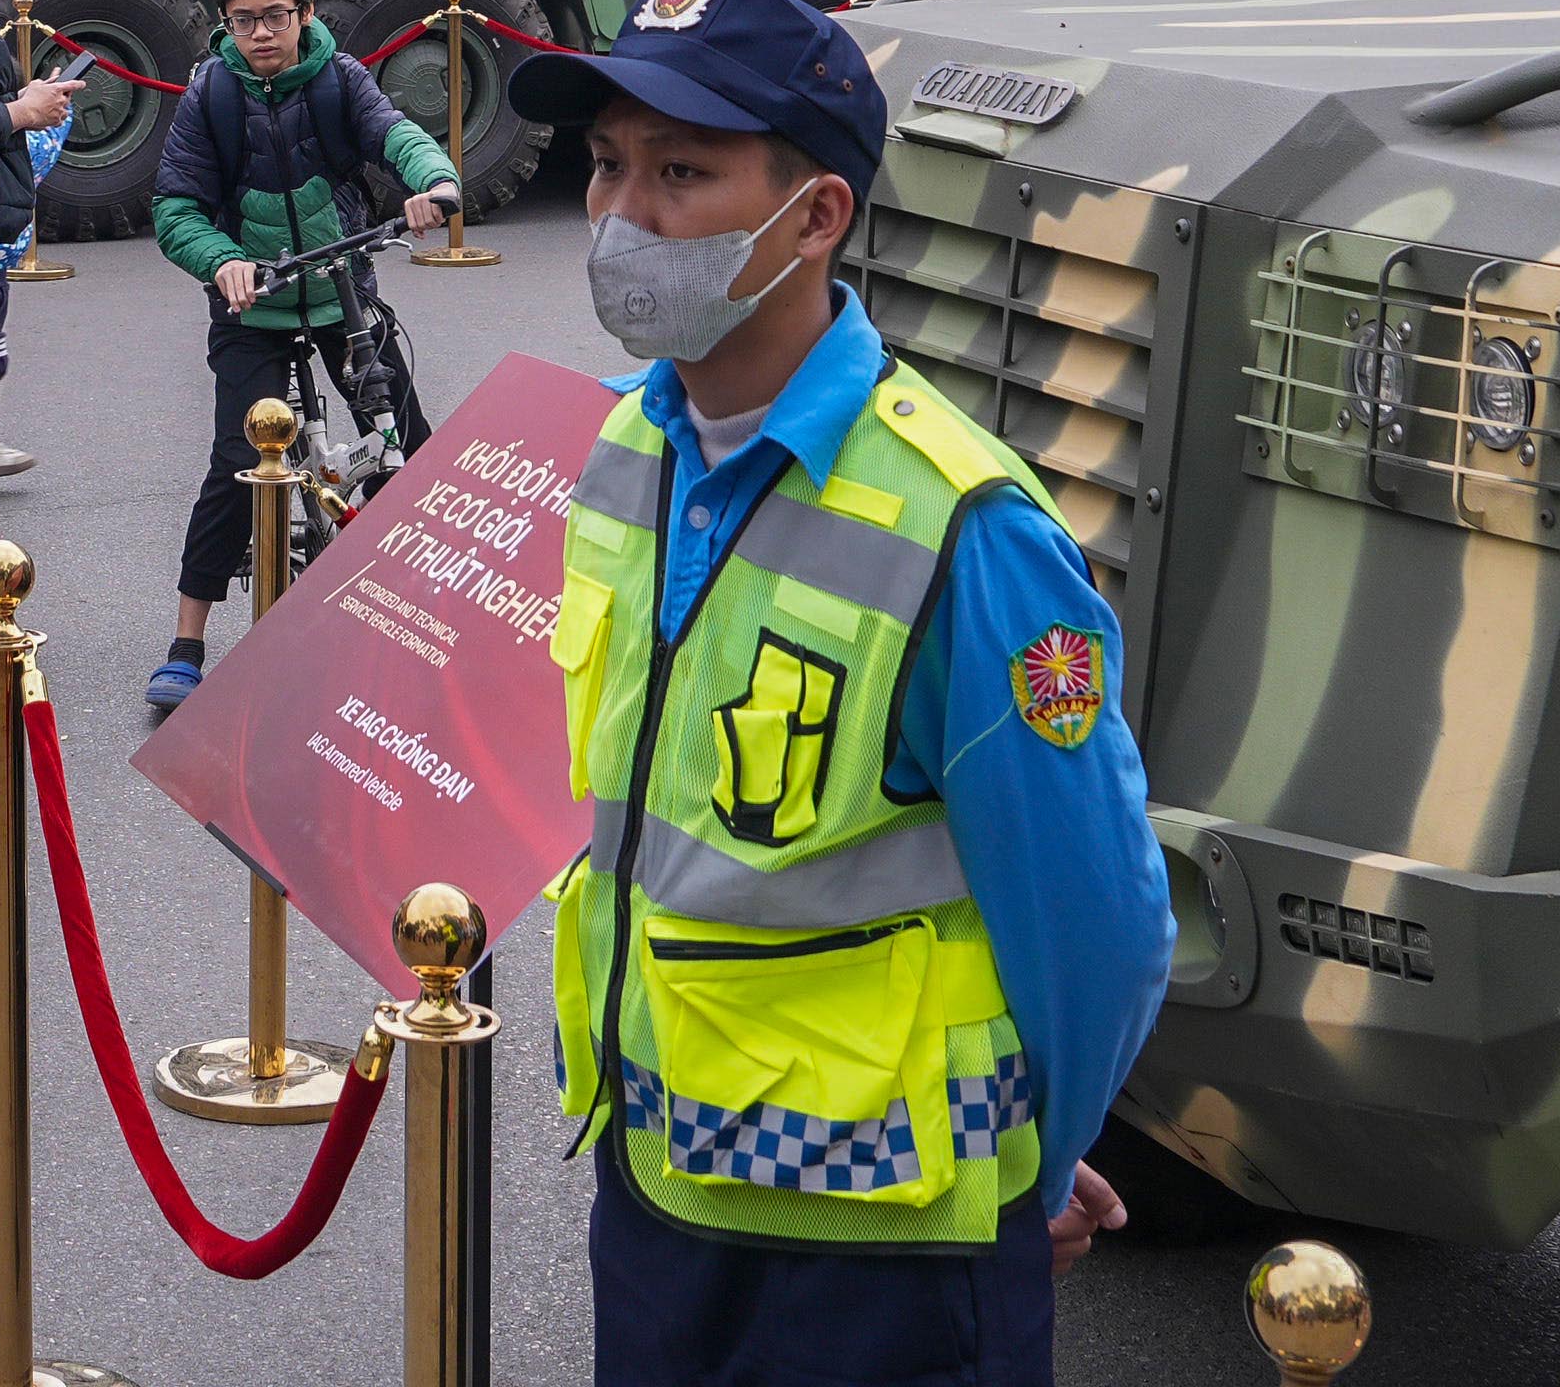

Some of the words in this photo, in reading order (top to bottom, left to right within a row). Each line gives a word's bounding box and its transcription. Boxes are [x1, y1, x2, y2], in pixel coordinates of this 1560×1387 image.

[920, 65, 1070, 119] GUARDIAN
[453, 439, 524, 484] KHỐI
[501, 459, 557, 506] ĐỘI
[377, 520, 425, 557] KỸ
[404, 531, 485, 594] THUẬT
[414, 479, 459, 517] XE
[442, 492, 491, 530] CƠ
[472, 507, 534, 562] GIỚI,
[339, 594, 373, 622] SERVICE
[367, 609, 404, 641] VEHICLE
[397, 629, 451, 669] FORMATION
[355, 577, 401, 611] MOTORIZED
[394, 597, 417, 619] AND
[412, 607, 461, 648] TECHNICAL
[306, 731, 330, 755] IAG
[321, 743, 367, 783] Armored
[363, 770, 405, 813] Vehicle
[336, 694, 365, 723] XE
[354, 704, 387, 740] IAG
[378, 724, 439, 776] CHỐNG
[429, 761, 476, 804] ĐẠN
